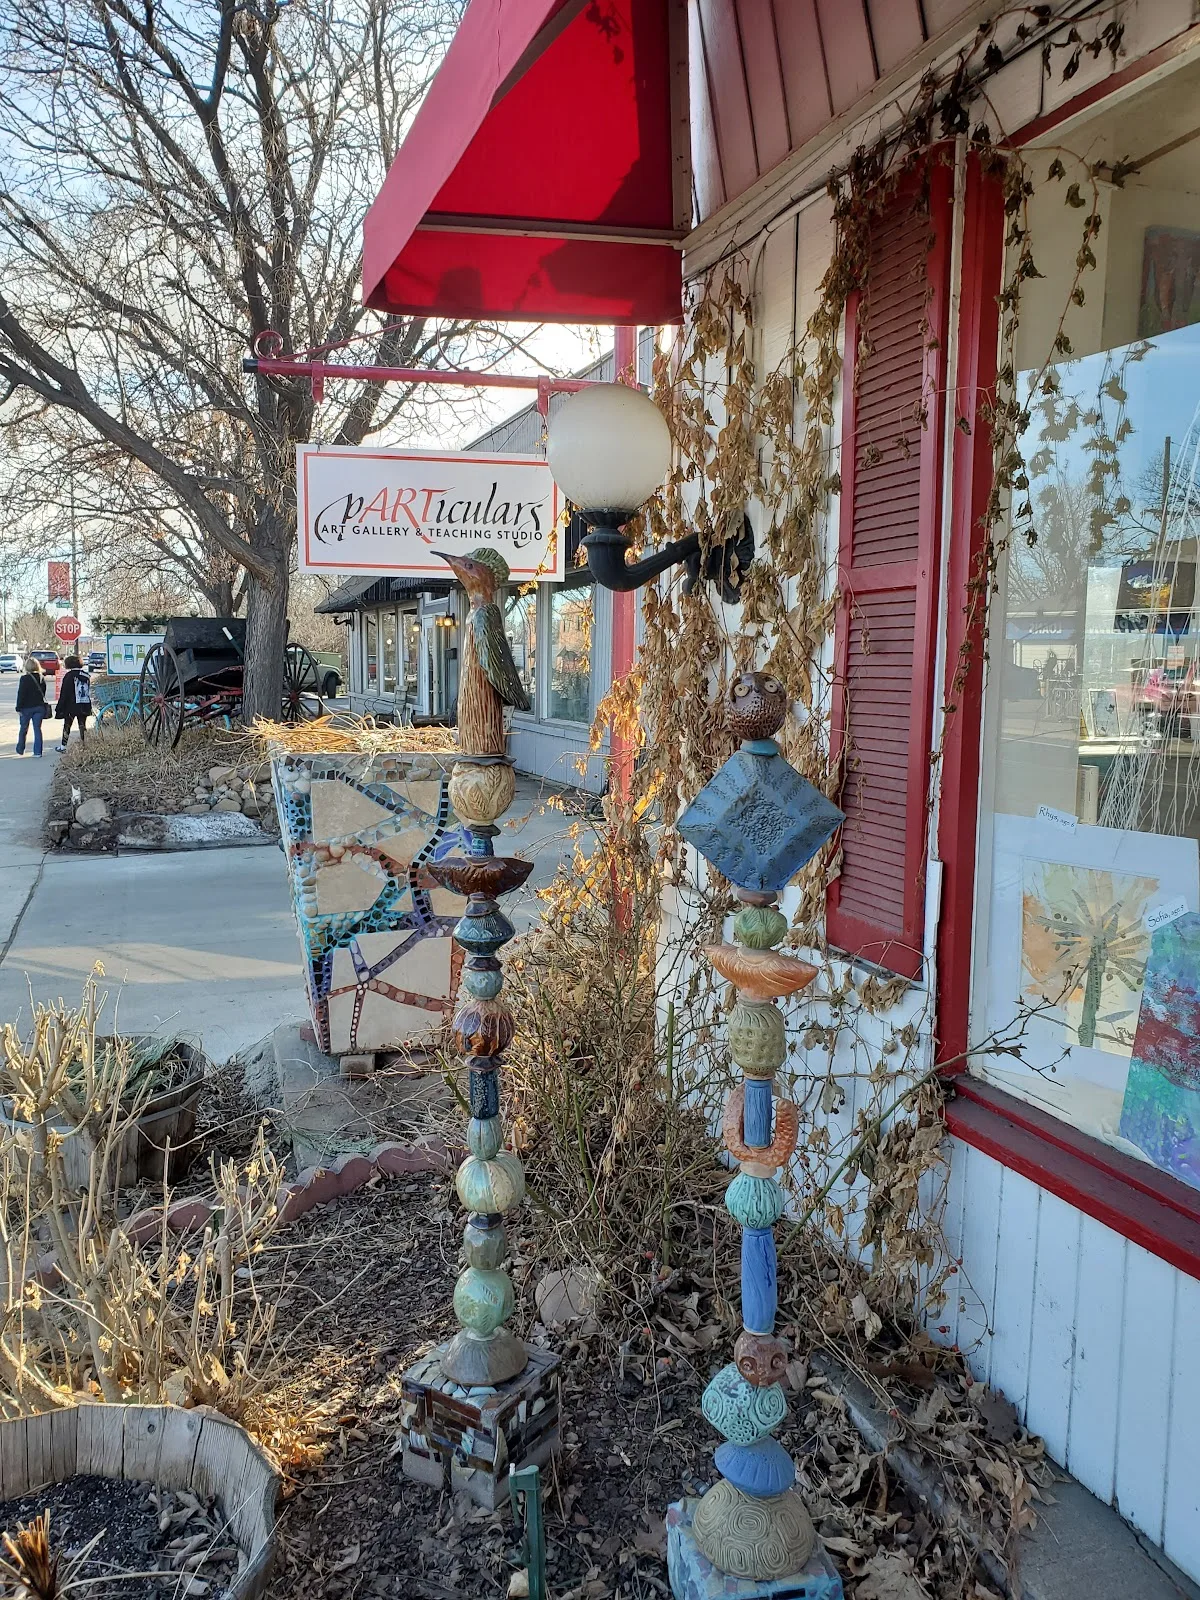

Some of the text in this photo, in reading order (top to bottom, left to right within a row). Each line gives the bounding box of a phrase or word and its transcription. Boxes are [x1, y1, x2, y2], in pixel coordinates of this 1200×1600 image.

[314, 482, 550, 548] pARTiculars
[321, 524, 543, 541] ART GALLERY & TEACHING STUDIO
[56, 623, 80, 634] STOP
[1147, 910, 1171, 928] Sofia,
